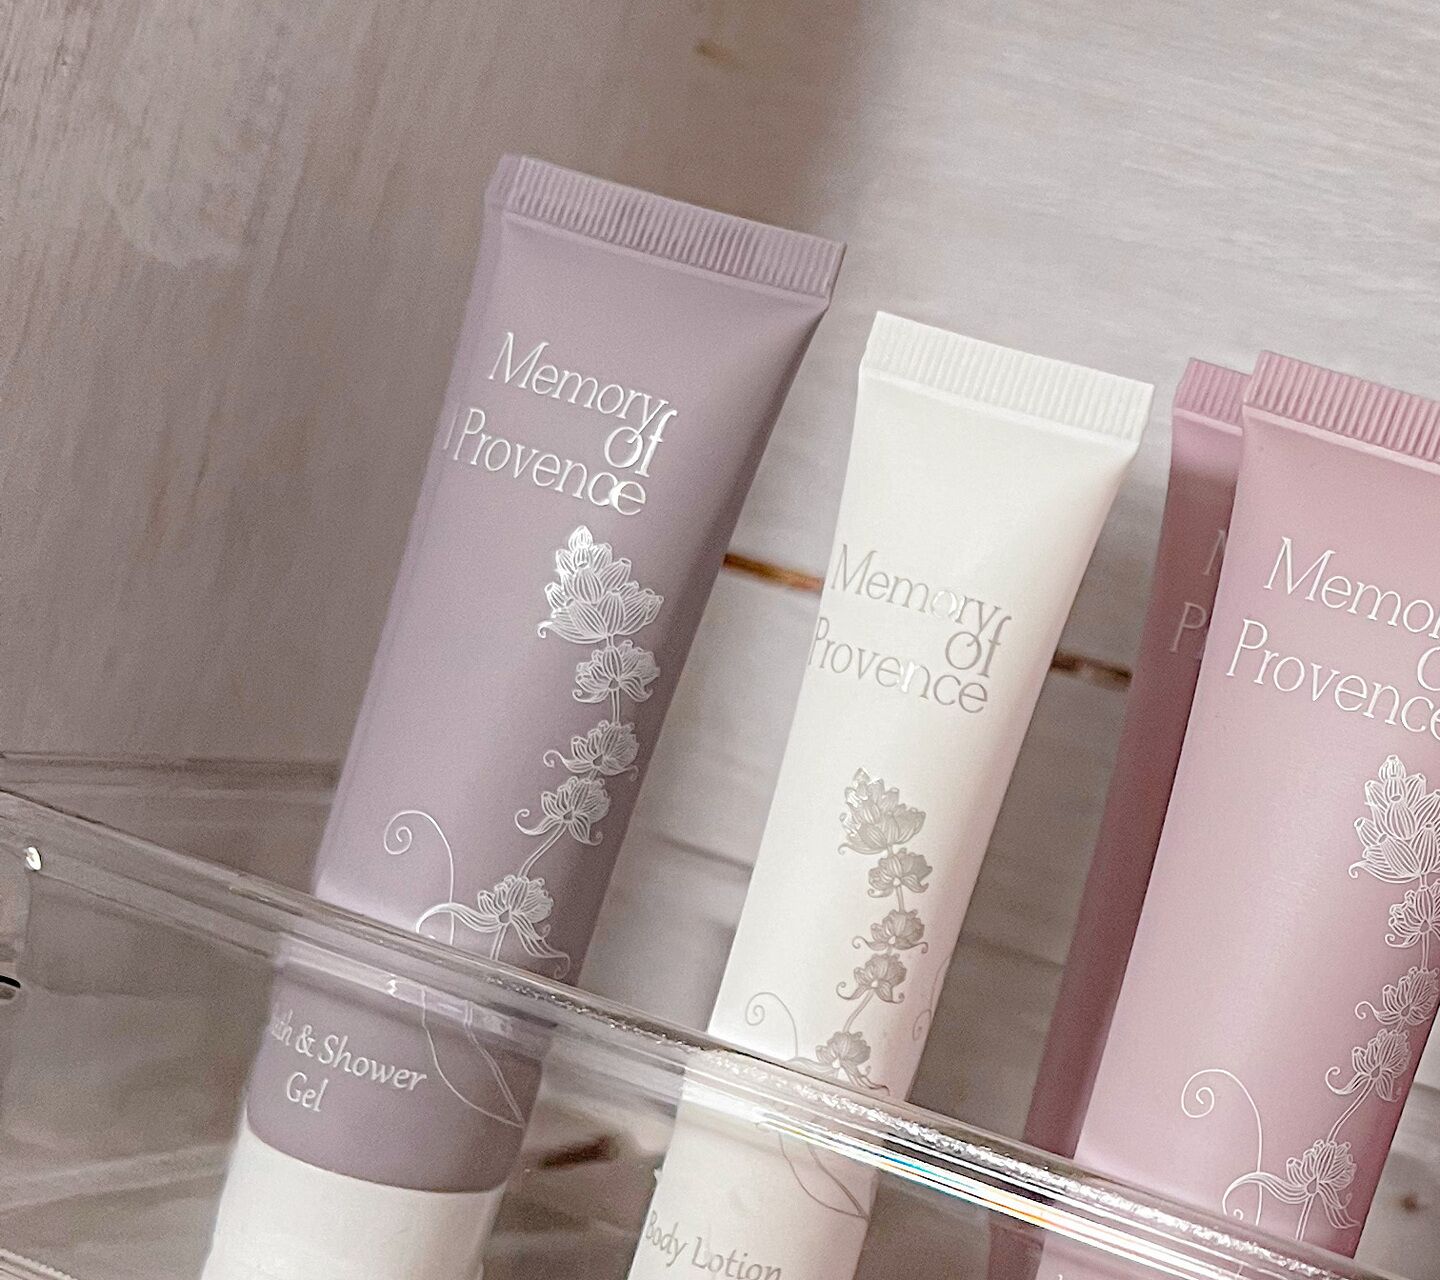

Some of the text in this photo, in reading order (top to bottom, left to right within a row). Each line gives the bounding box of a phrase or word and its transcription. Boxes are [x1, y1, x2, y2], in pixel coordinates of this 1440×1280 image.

[488, 331, 670, 443] Memory
[452, 407, 647, 516] Provence
[830, 543, 1002, 648] Memory
[808, 616, 988, 714] Provence
[285, 1071, 329, 1113] Gel
[295, 1024, 316, 1057] &
[317, 1033, 428, 1091] Shower
